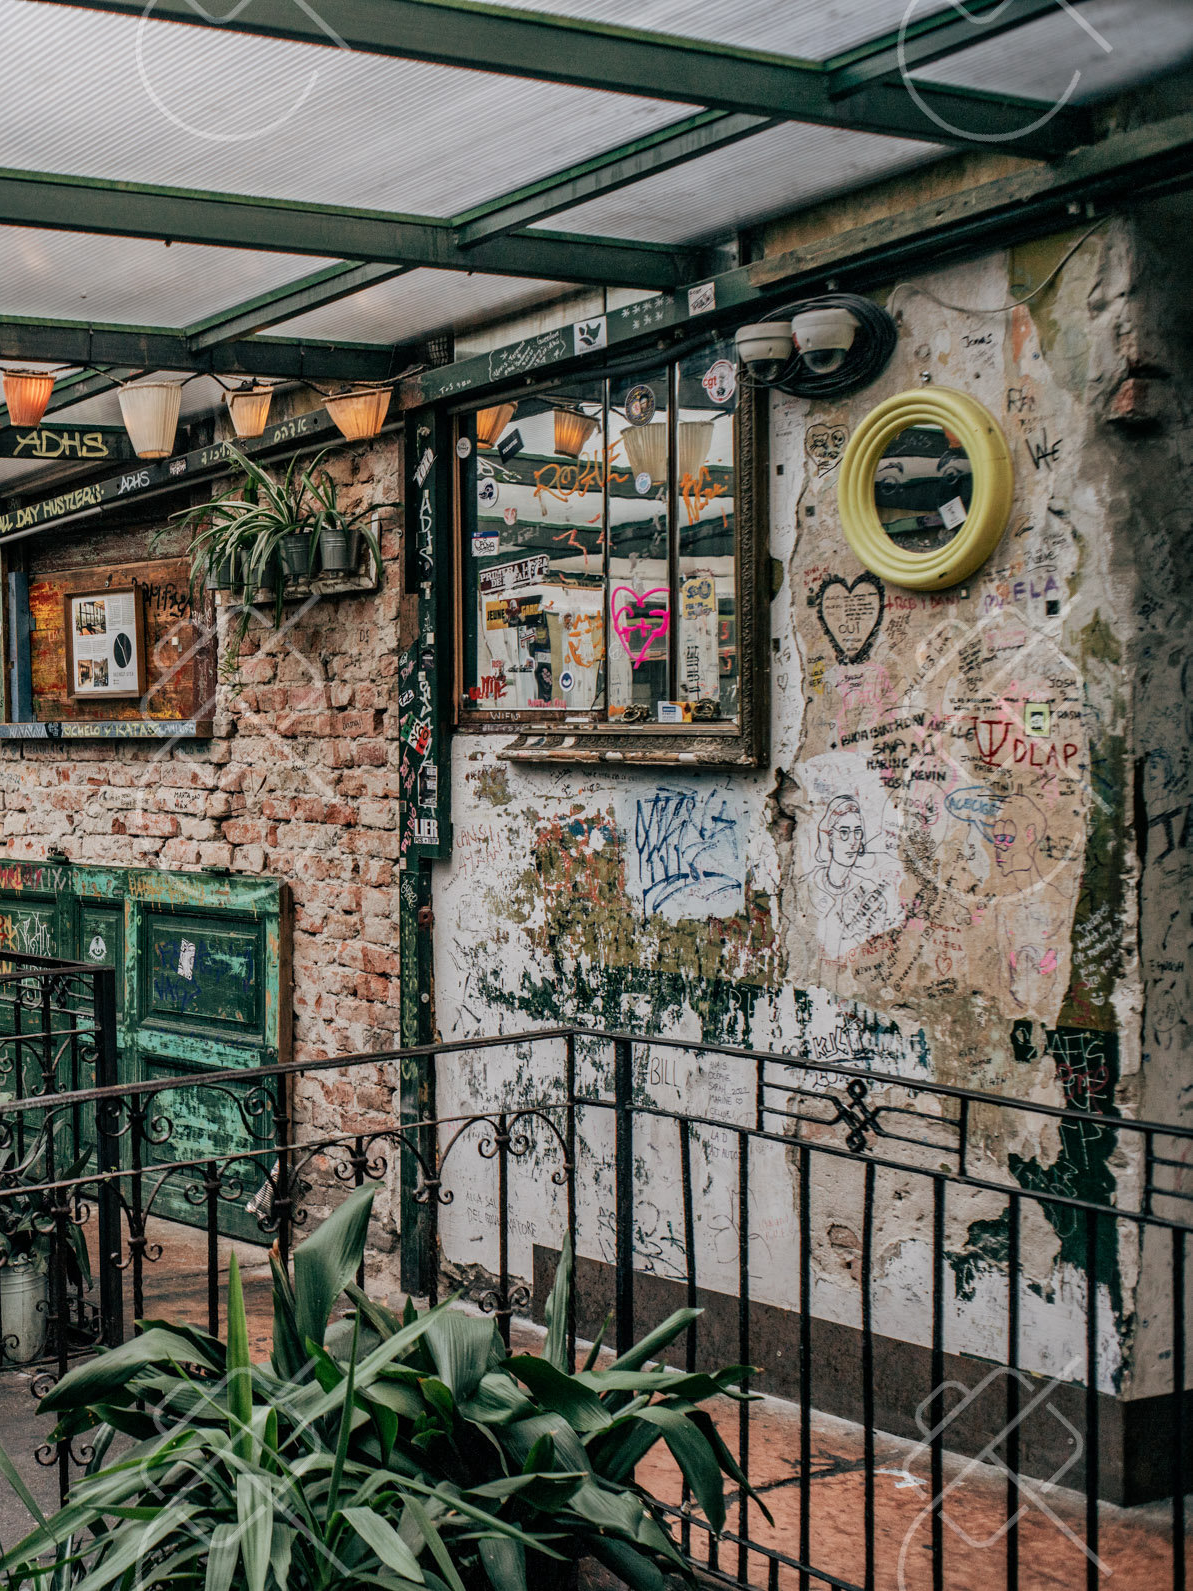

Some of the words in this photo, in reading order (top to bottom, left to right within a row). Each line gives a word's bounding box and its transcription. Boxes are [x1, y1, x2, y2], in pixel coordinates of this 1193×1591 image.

[702, 375, 717, 389] cgt
[13, 431, 109, 458] ADHS
[116, 470, 151, 495] ADHS
[15, 506, 40, 529] DAY
[911, 769, 946, 782] KEVIN
[650, 1056, 680, 1088] BILL
